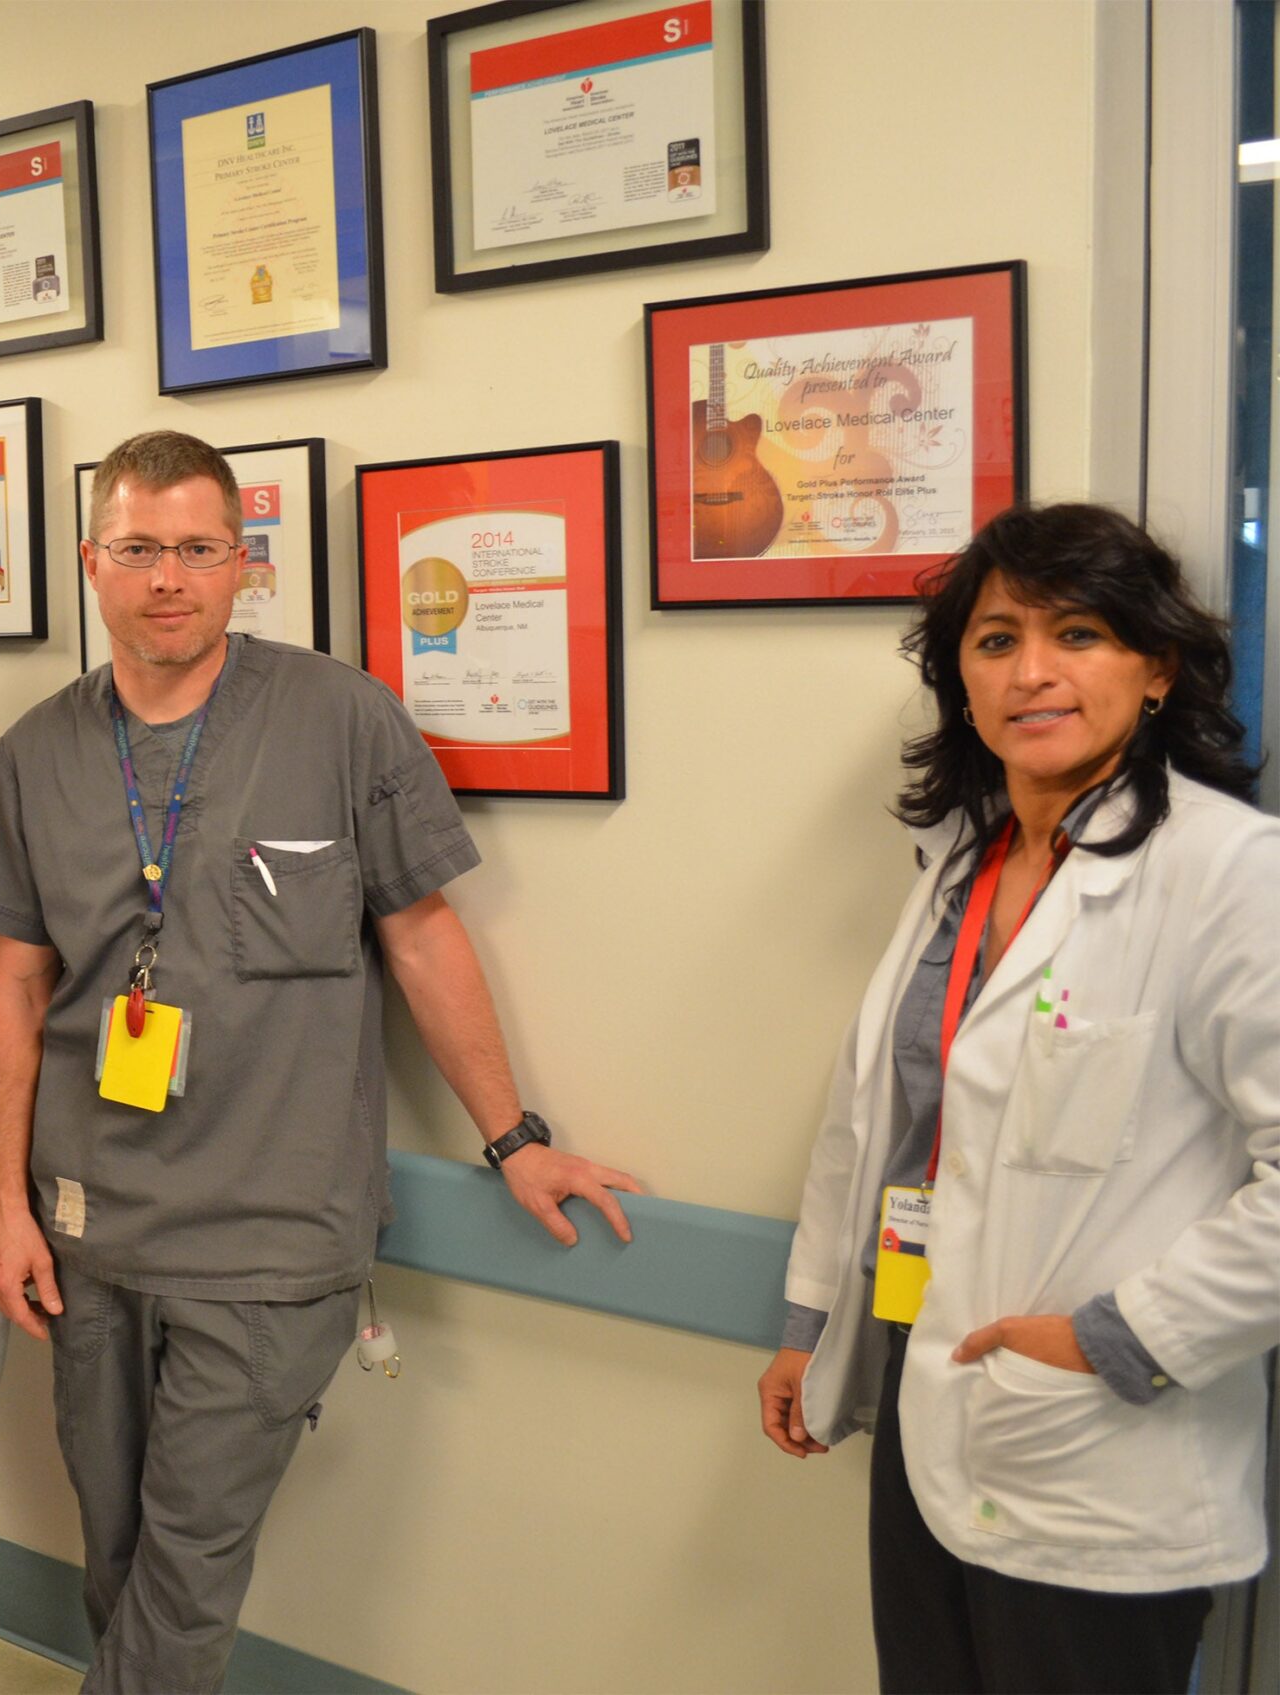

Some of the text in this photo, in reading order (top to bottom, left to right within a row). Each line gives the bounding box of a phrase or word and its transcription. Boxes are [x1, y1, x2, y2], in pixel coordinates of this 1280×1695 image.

[544, 122, 577, 135] LOVELACE
[579, 116, 606, 128] MEDICAL
[608, 111, 635, 123] CENTER
[30, 156, 44, 177] S
[744, 341, 958, 385] Quality Achievement Award
[800, 373, 870, 404] presented
[765, 407, 955, 433] Lovelace Medical Center
[834, 446, 855, 471] for
[797, 475, 925, 489] Gold Plus Performance Award
[817, 491, 845, 500] Stroke
[847, 490, 874, 499] Honor
[875, 488, 892, 497] Roll
[917, 486, 937, 495] Plus
[253, 490, 271, 515] S
[471, 531, 515, 549] 2014
[472, 547, 544, 560] INTERNATIONAL
[472, 558, 510, 569] STROKE
[473, 566, 536, 578] CONFERENCE
[407, 590, 459, 606] GOLD
[475, 599, 545, 611] Lovelace Medical
[412, 607, 455, 617] ACHIEVEMENT
[476, 613, 503, 623] Center
[420, 637, 449, 646] PLUS
